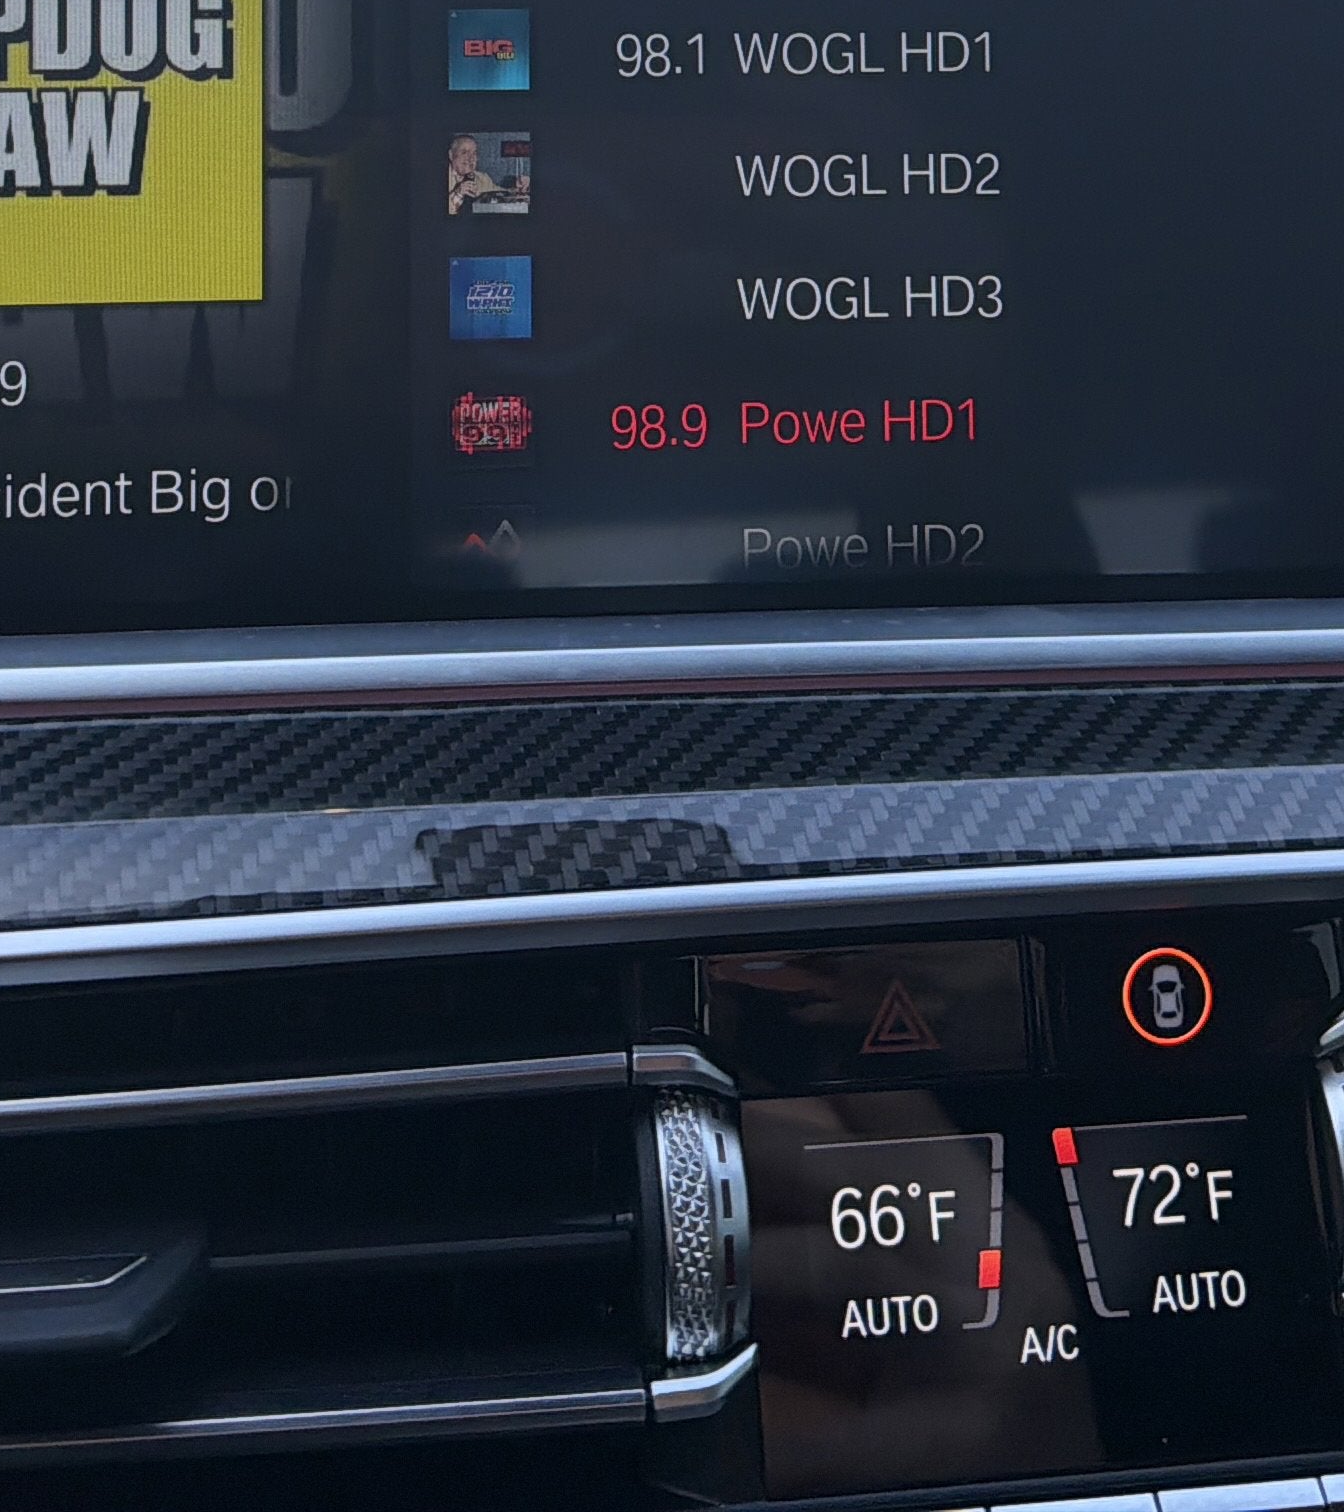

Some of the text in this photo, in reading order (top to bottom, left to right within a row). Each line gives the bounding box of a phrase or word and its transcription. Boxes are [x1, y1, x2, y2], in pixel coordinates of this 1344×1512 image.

[464, 40, 514, 57] BIG
[617, 32, 990, 77] 98.1 WOGL HD1
[736, 153, 1000, 196] WOGL HD2
[737, 276, 1002, 320] WOGL HD3
[612, 399, 974, 449] 98.9 Powe HD1
[152, 469, 229, 522] Big
[744, 524, 985, 568] Powe HD2
[832, 1183, 955, 1249] 66°F
[1113, 1163, 1232, 1226] 72°F
[1153, 1270, 1245, 1313] AUTO
[842, 1295, 938, 1338] AUTO
[1021, 1324, 1079, 1364] A/C
